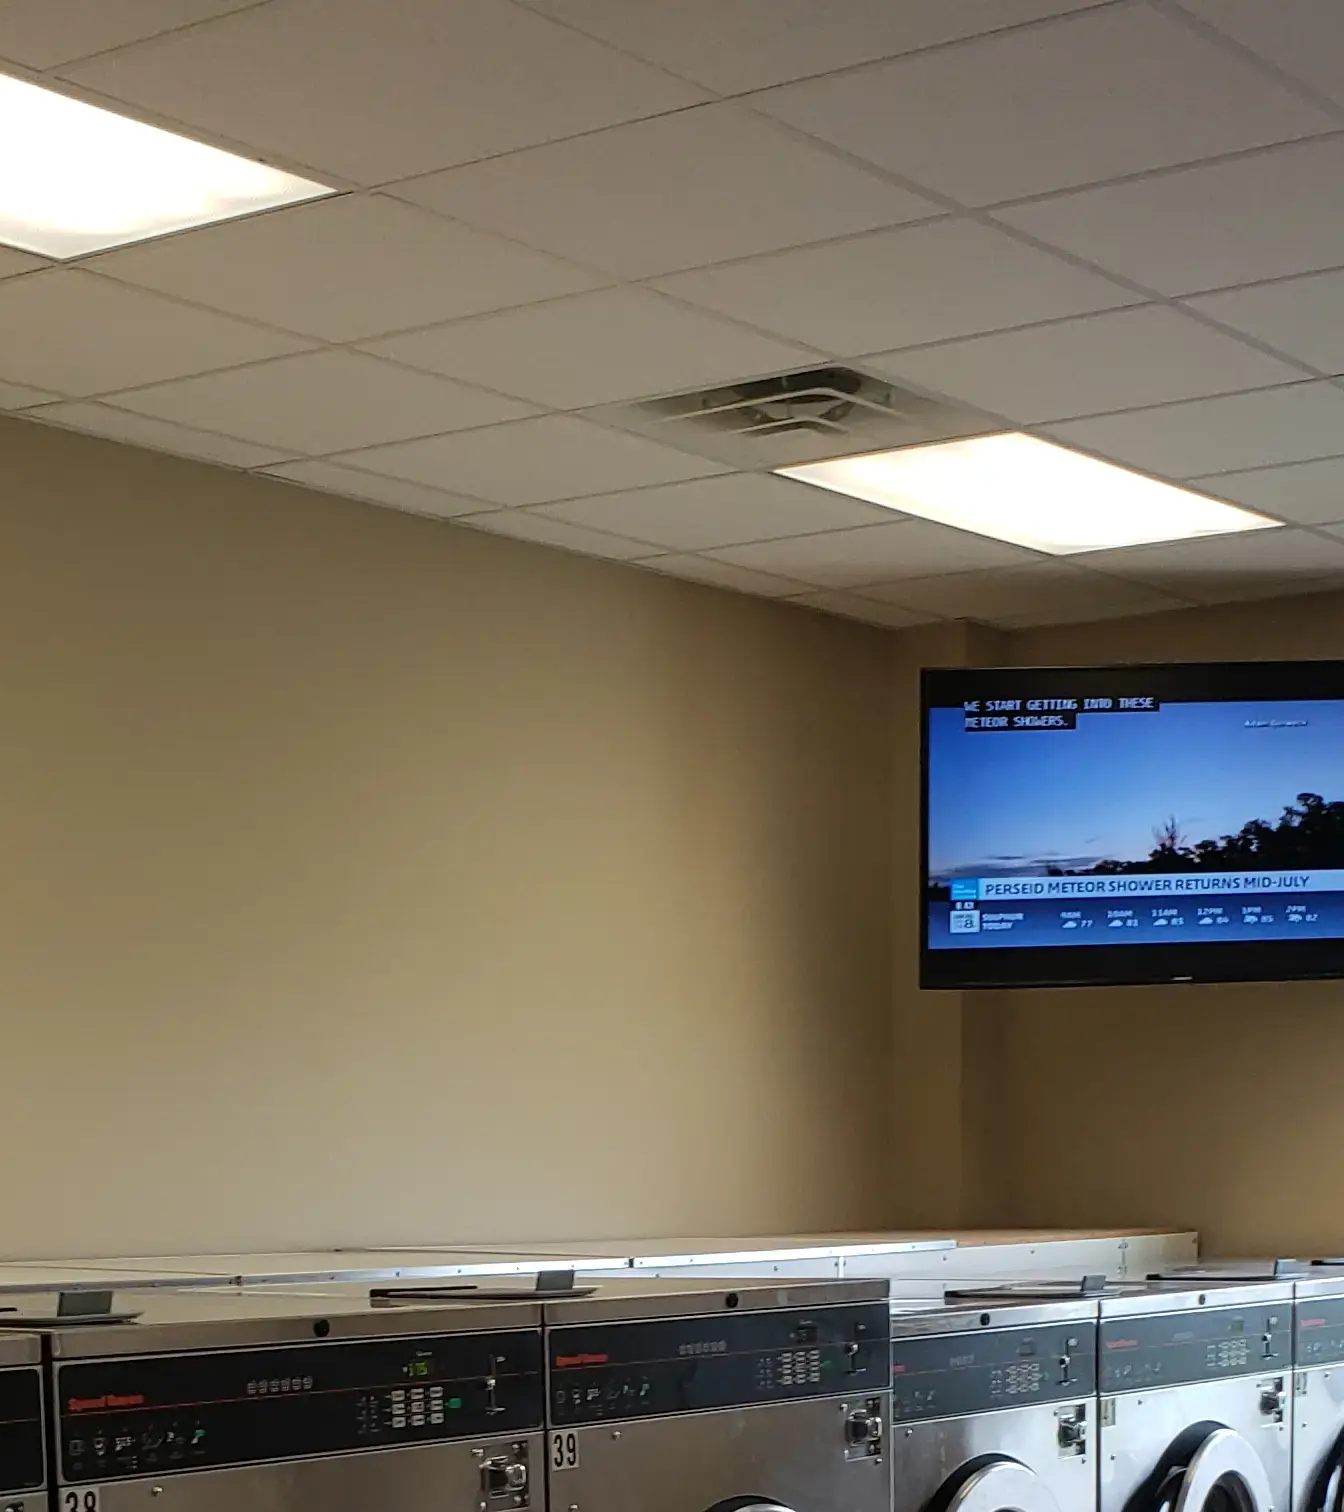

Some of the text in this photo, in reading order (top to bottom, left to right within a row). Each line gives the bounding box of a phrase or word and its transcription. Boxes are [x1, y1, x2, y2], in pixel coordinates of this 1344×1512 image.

[964, 697, 1155, 712] WE START GETTING INTO THESE
[964, 715, 1069, 728] METEOR SHOWERS.
[985, 883, 1044, 895] PERSEID
[1047, 881, 1106, 894] METEOR
[1109, 879, 1172, 892] SHOWER
[1175, 877, 1240, 890] RETURNS
[1244, 876, 1310, 888] MID-JULY
[554, 1433, 576, 1467] 39
